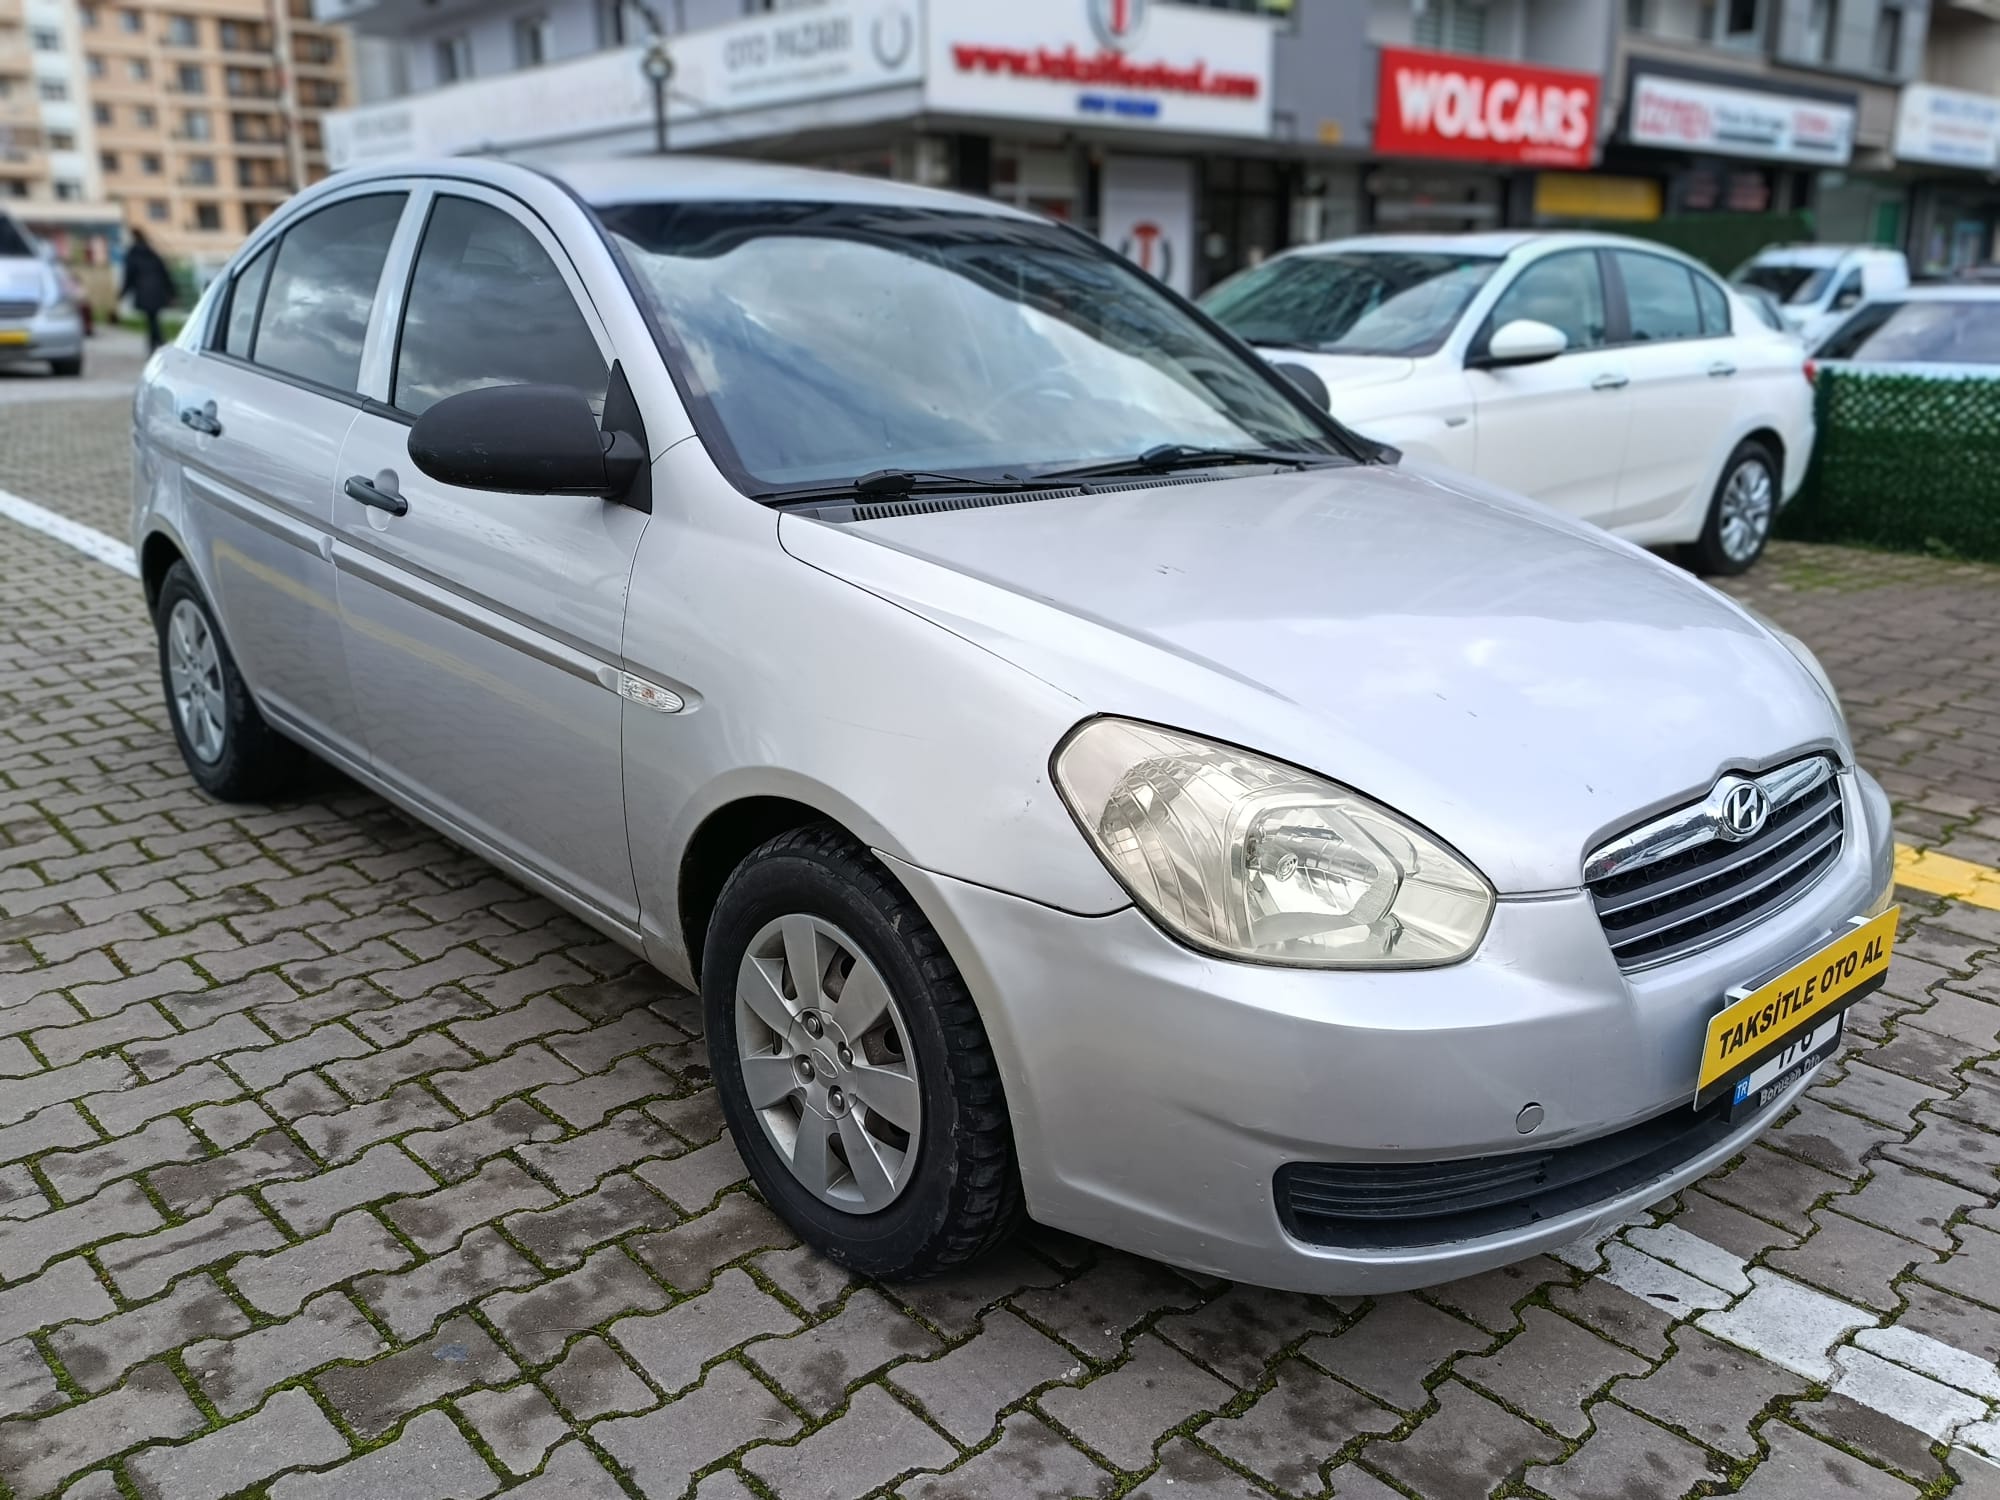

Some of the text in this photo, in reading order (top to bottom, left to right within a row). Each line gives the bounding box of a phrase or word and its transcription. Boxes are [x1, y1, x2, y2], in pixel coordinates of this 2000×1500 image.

[1396, 68, 1590, 148] WOLCARS
[1719, 975, 1817, 1060] TAKSİTLE
[1820, 950, 1858, 994] OTO
[1860, 935, 1883, 969] AL
[1736, 1082, 1748, 1099] TR
